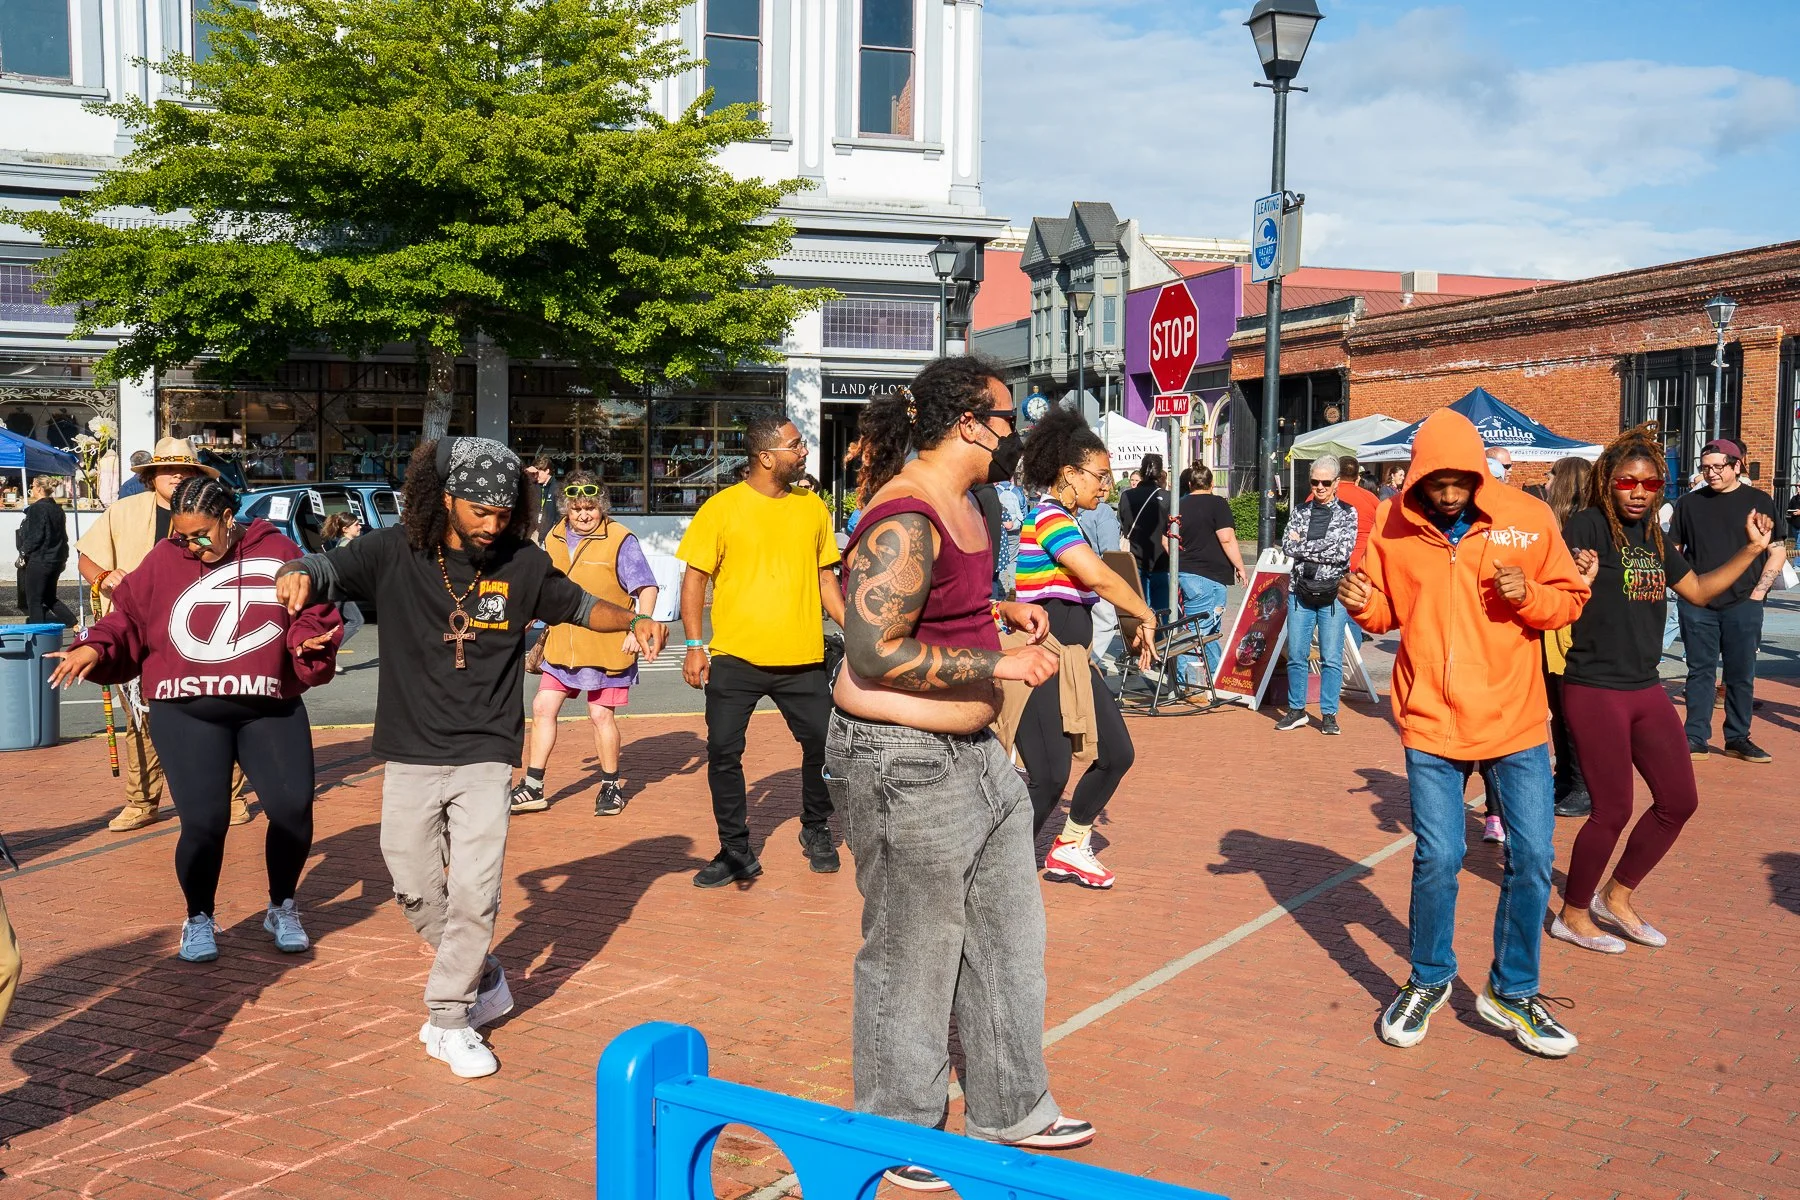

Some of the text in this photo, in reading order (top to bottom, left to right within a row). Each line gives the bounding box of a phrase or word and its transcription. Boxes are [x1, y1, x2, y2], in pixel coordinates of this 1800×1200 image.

[1257, 197, 1279, 215] LEAVING
[1258, 245, 1274, 256] HAZARD
[1260, 255, 1271, 266] ZONE
[1152, 315, 1195, 361] STOP
[831, 383, 866, 395] LAND
[1156, 398, 1188, 412] ALL WAY
[1474, 424, 1536, 441] Familia
[1623, 568, 1666, 586] GIFTED
[478, 579, 509, 600] BLACK
